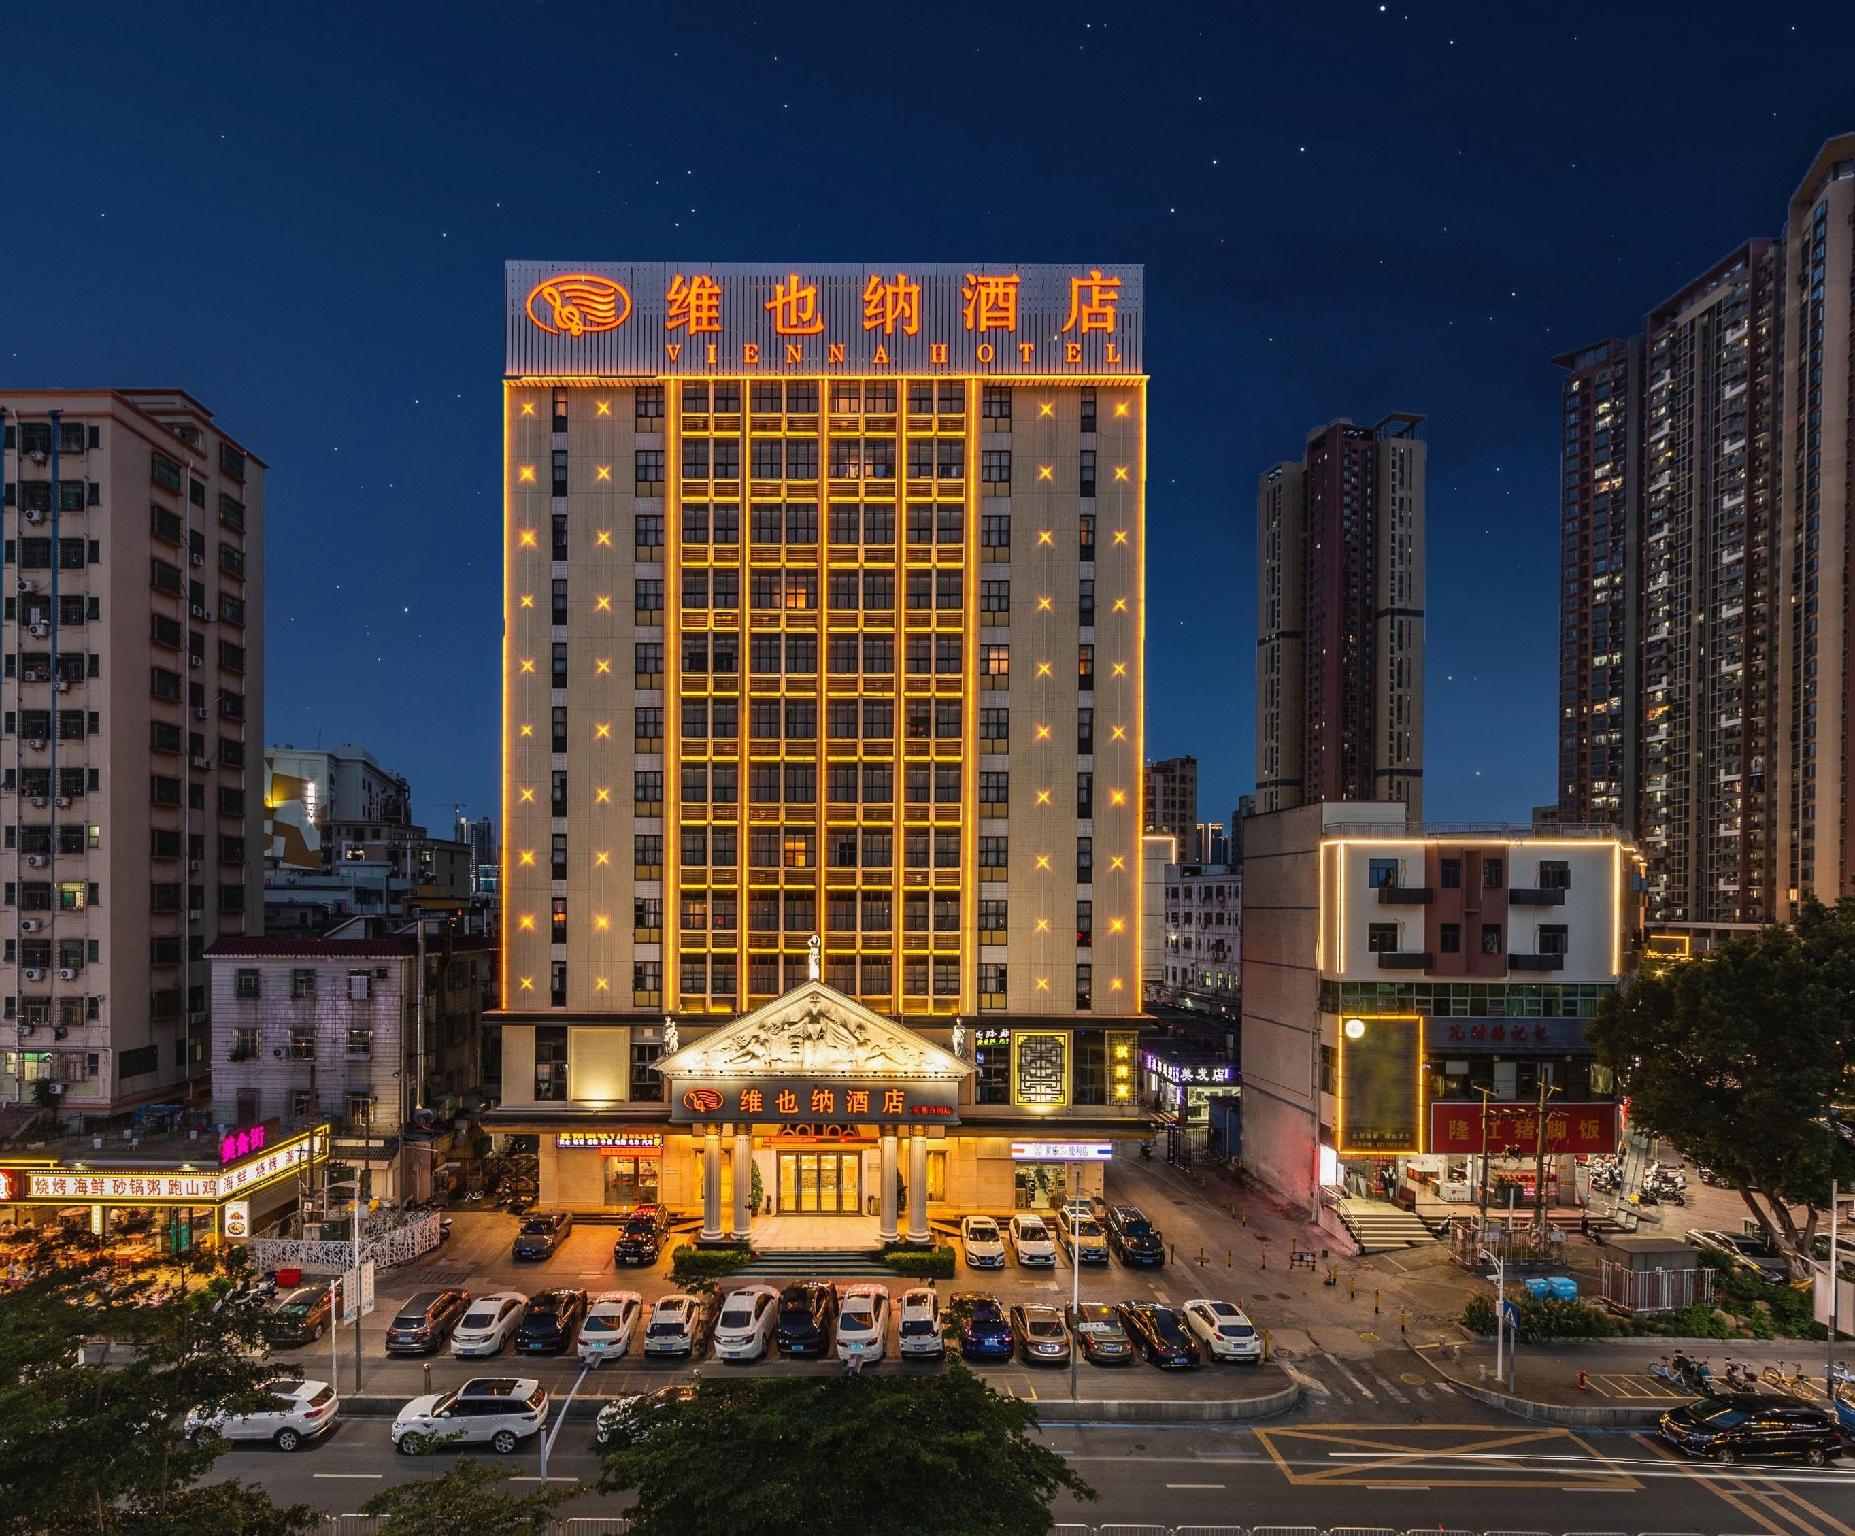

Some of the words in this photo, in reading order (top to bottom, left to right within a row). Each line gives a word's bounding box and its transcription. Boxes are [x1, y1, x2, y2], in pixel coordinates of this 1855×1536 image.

[666, 271, 1121, 336] 维也纳酒店
[666, 344, 889, 365] VIENNA
[930, 343, 1121, 364] HOTEL
[740, 1089, 905, 1114] 维也纳酒店
[1449, 1119, 1600, 1140] 隆江猪脚饭
[222, 1126, 265, 1163] 美食街
[34, 1177, 67, 1195] 烧烤
[73, 1178, 106, 1196] 海鲜
[112, 1178, 161, 1196] 砂锅粥
[168, 1178, 217, 1197] 跑山鸡
